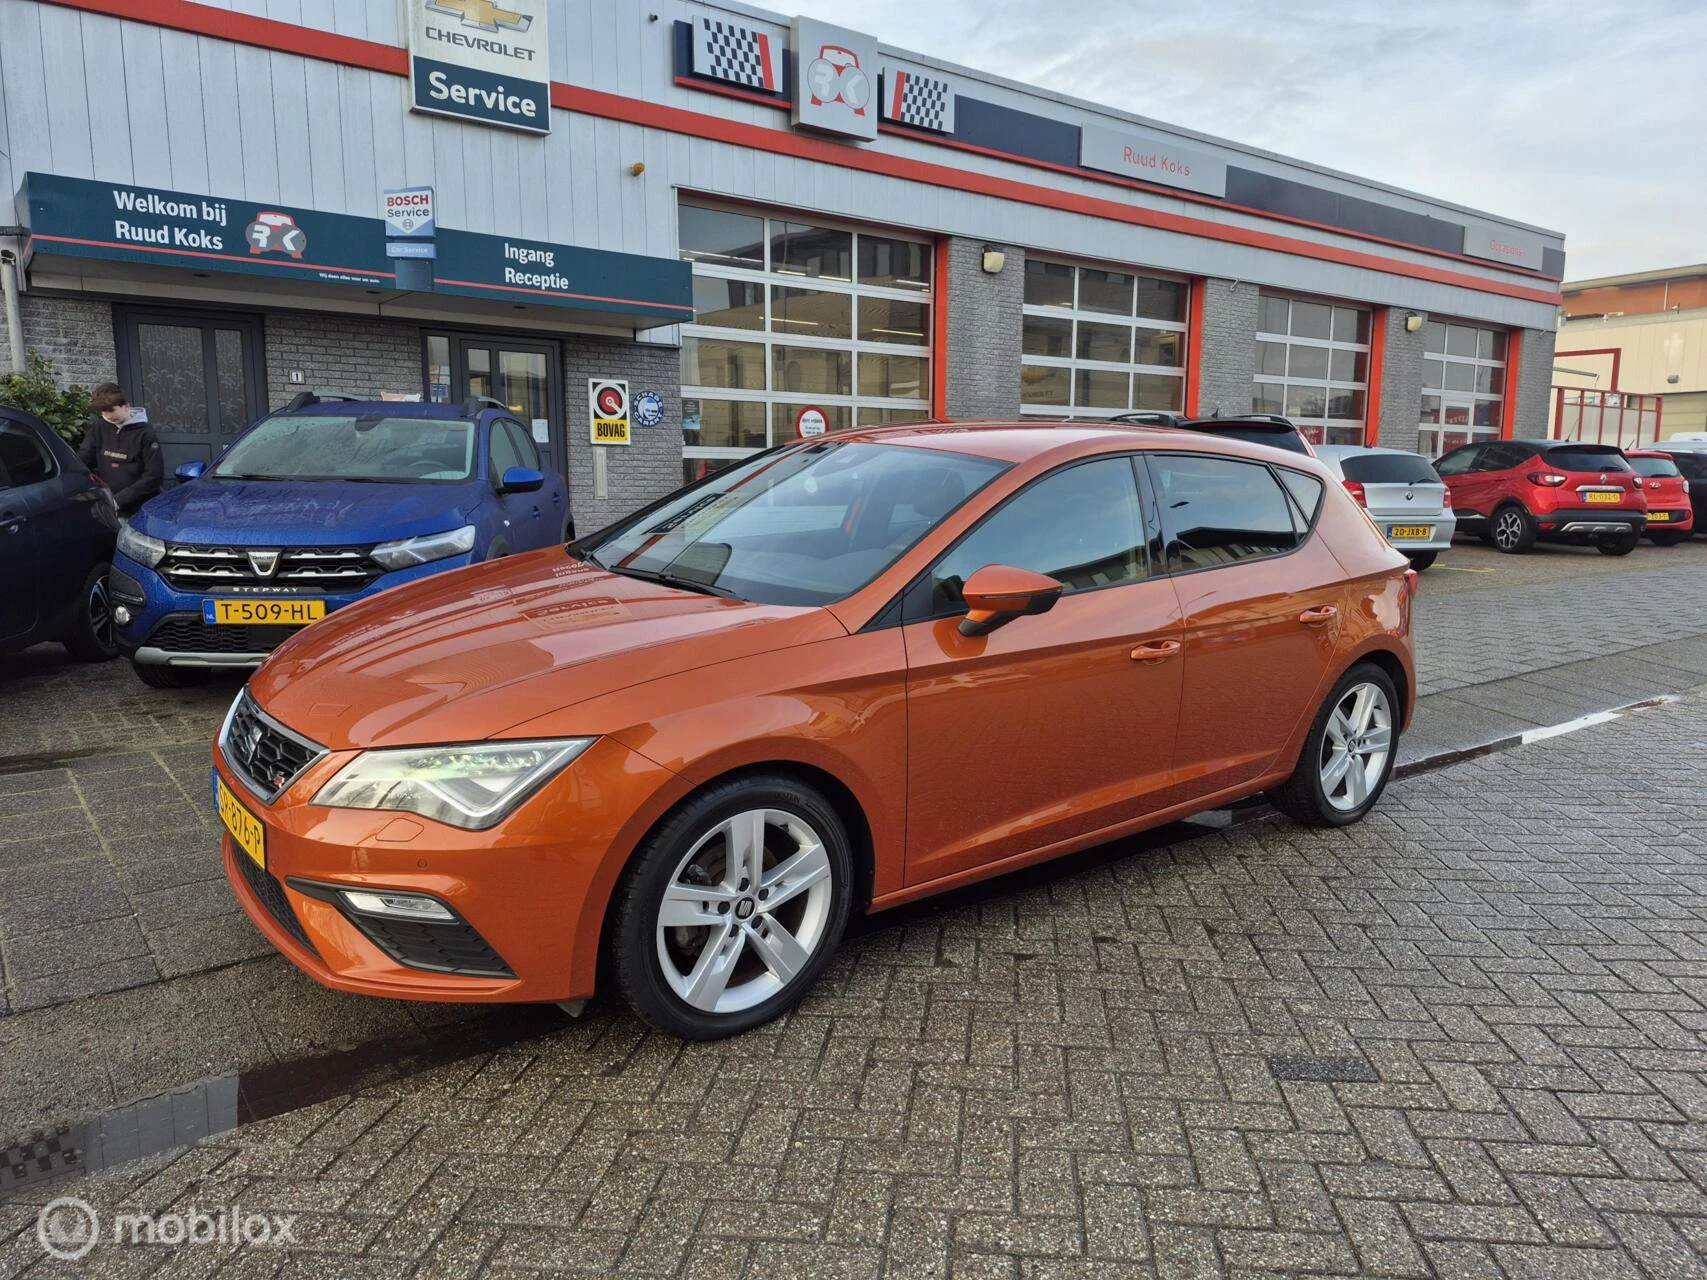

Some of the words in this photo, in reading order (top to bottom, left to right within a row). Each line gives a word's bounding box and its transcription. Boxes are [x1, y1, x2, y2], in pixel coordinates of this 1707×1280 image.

[425, 26, 536, 61] CHEVROLET
[429, 71, 537, 117] Service
[1123, 146, 1156, 168] Ruud
[1160, 155, 1191, 176] Koks
[113, 190, 198, 219] Welkom
[201, 201, 227, 227] bij
[387, 194, 429, 207] BOSCH
[387, 207, 430, 217] Service
[115, 220, 170, 245] Ruud
[174, 227, 224, 250] Koks
[504, 243, 554, 267] Ingang
[504, 267, 569, 290] Receptie
[597, 423, 625, 438] BOVAG
[1395, 528, 1428, 536] 20-JXB-8
[221, 603, 318, 620] T-509-HL
